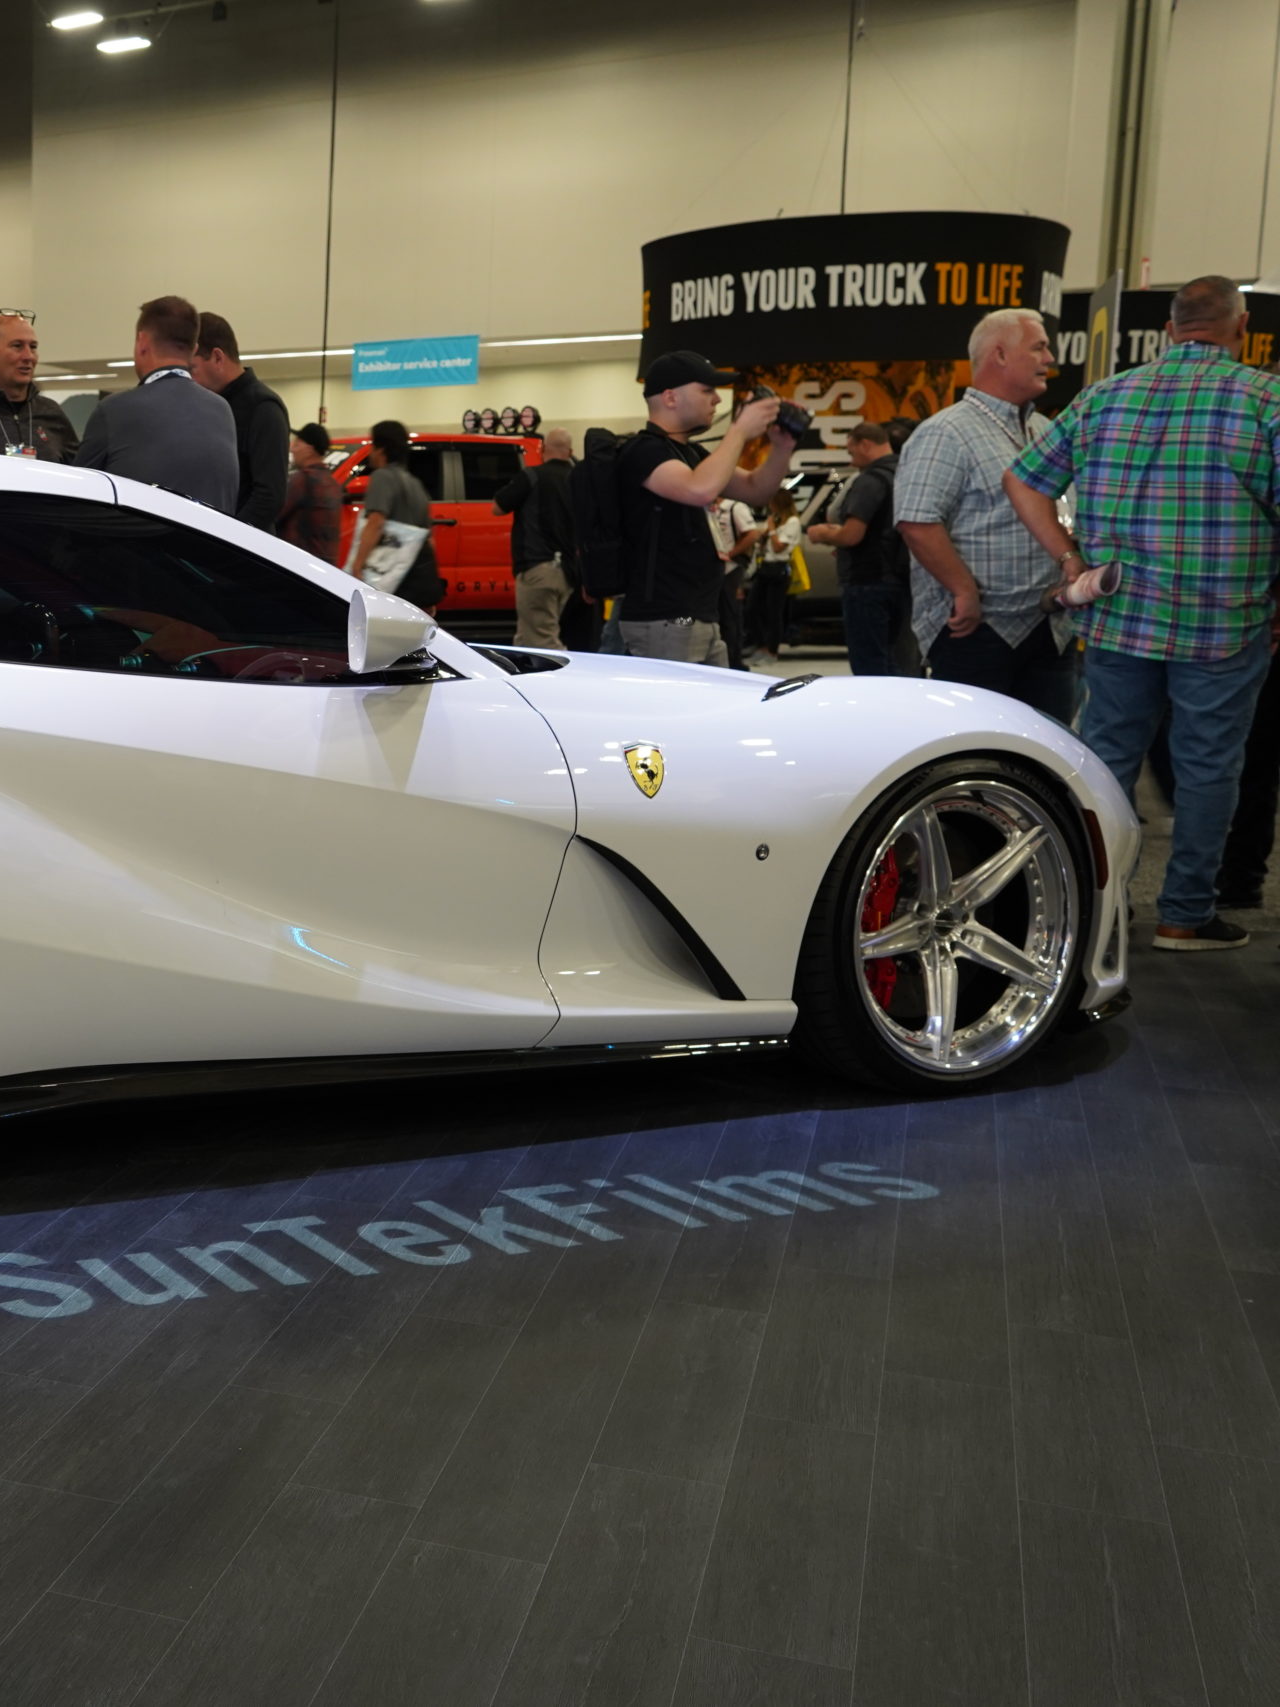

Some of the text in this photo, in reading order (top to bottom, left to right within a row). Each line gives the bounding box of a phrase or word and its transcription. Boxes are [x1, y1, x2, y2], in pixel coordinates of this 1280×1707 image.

[671, 273, 734, 322] BRING
[741, 266, 816, 313] YOUR
[825, 262, 928, 307] TRUCK
[934, 262, 968, 305] TO
[976, 263, 1023, 307] LIFE
